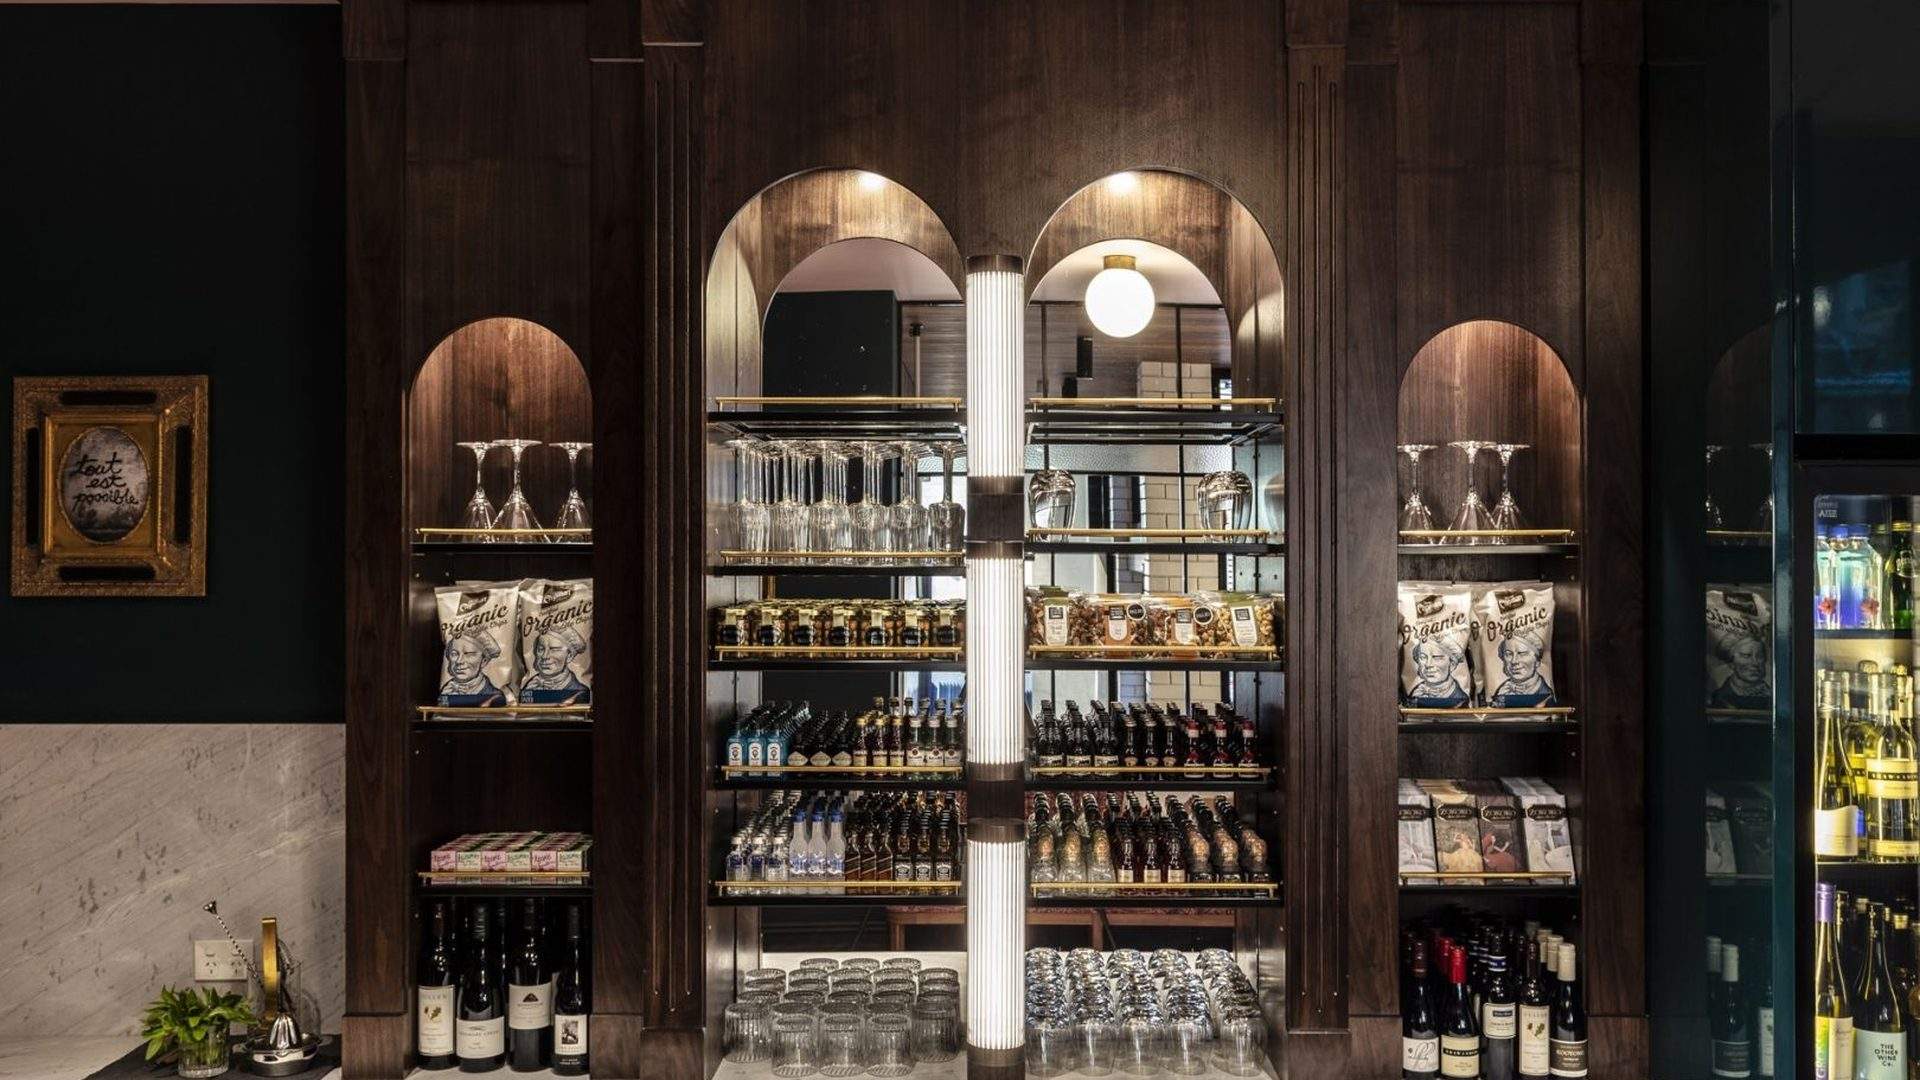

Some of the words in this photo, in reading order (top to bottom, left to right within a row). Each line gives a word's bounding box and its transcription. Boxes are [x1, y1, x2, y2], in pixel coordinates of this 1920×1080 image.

[85, 475, 126, 489] est
[441, 604, 508, 640] Organic
[524, 600, 593, 637] Organic
[1402, 611, 1466, 645] Organic
[1487, 607, 1547, 641] Organic
